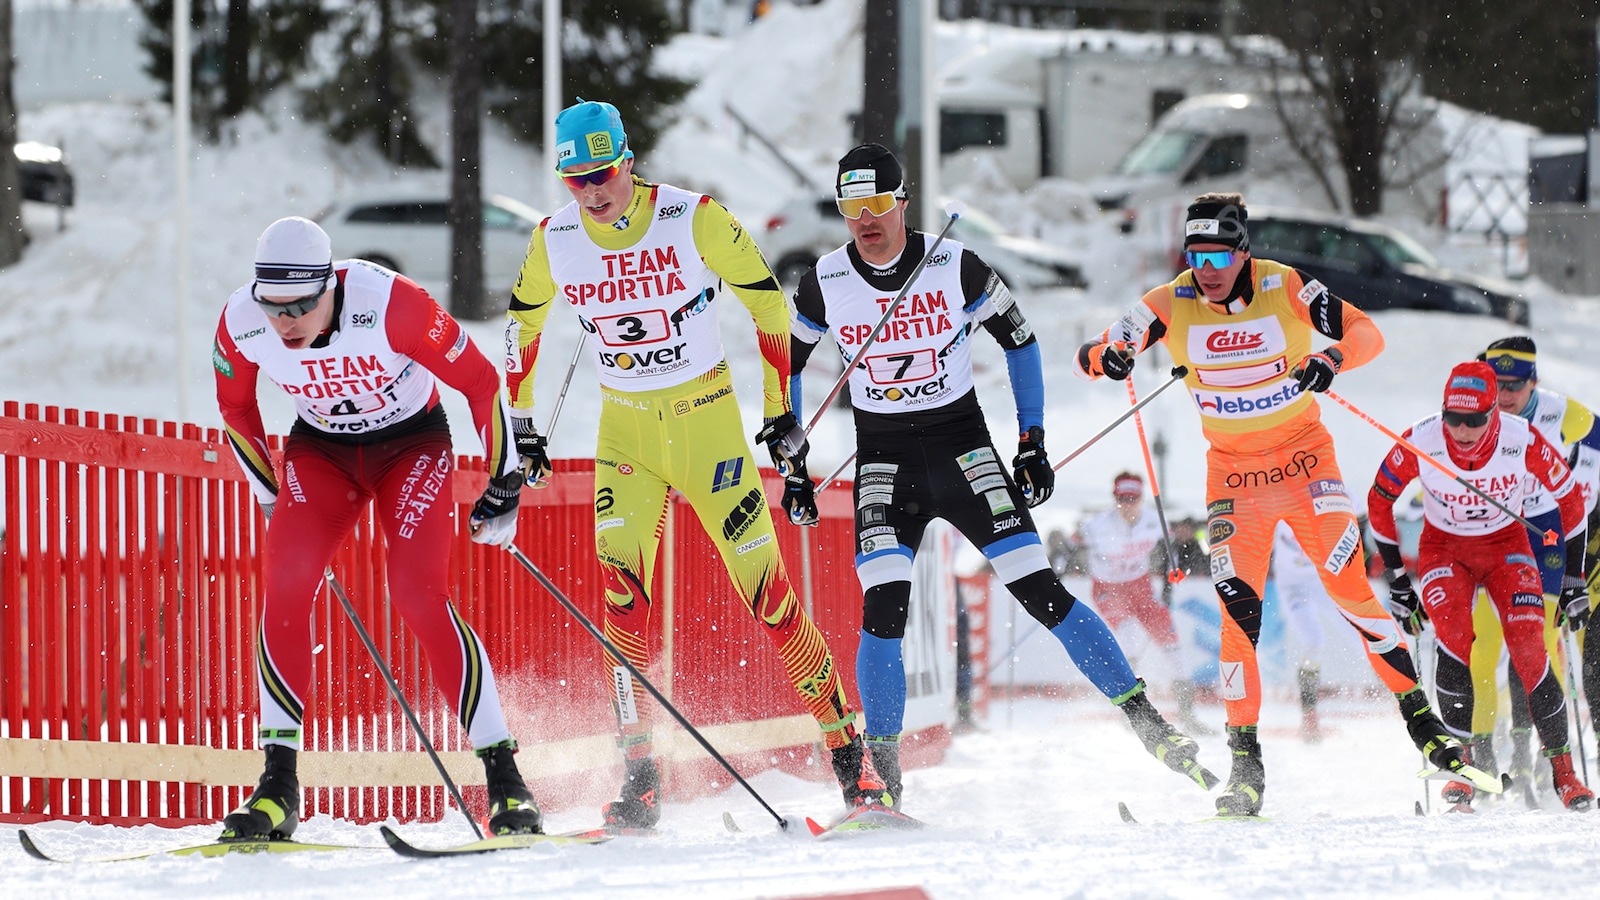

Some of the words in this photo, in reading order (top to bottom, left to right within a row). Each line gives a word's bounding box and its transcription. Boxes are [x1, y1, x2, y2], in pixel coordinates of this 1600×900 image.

[658, 205, 683, 217] SGN
[550, 224, 579, 232] HiKOKI
[602, 245, 680, 278] TEAM
[927, 253, 949, 265] SGN
[820, 270, 849, 280] HiKOKI
[563, 272, 687, 306] SPORTIA
[876, 290, 948, 318] TEAM
[352, 314, 374, 324] SGN
[234, 327, 266, 341] HiKOKI
[616, 316, 647, 342] 3
[840, 315, 952, 345] SPORTIA
[1206, 329, 1266, 352] Calix
[1206, 351, 1244, 360] Lämmittää
[1246, 347, 1268, 356] autosi
[301, 355, 385, 381] TEAM
[635, 358, 690, 376] SAINT-GOBAIN
[887, 355, 914, 380] 7
[281, 374, 393, 399] PORTIA
[330, 399, 362, 415] 4
[1195, 382, 1300, 414] Webasto
[860, 476, 894, 485] NORONEN
[1465, 474, 1518, 494] TEAM
[1465, 509, 1489, 520] 2
[861, 527, 894, 538] WECKMAN
[606, 555, 626, 567] Mine
[1212, 555, 1229, 575] SP
[616, 671, 630, 720] POWER
